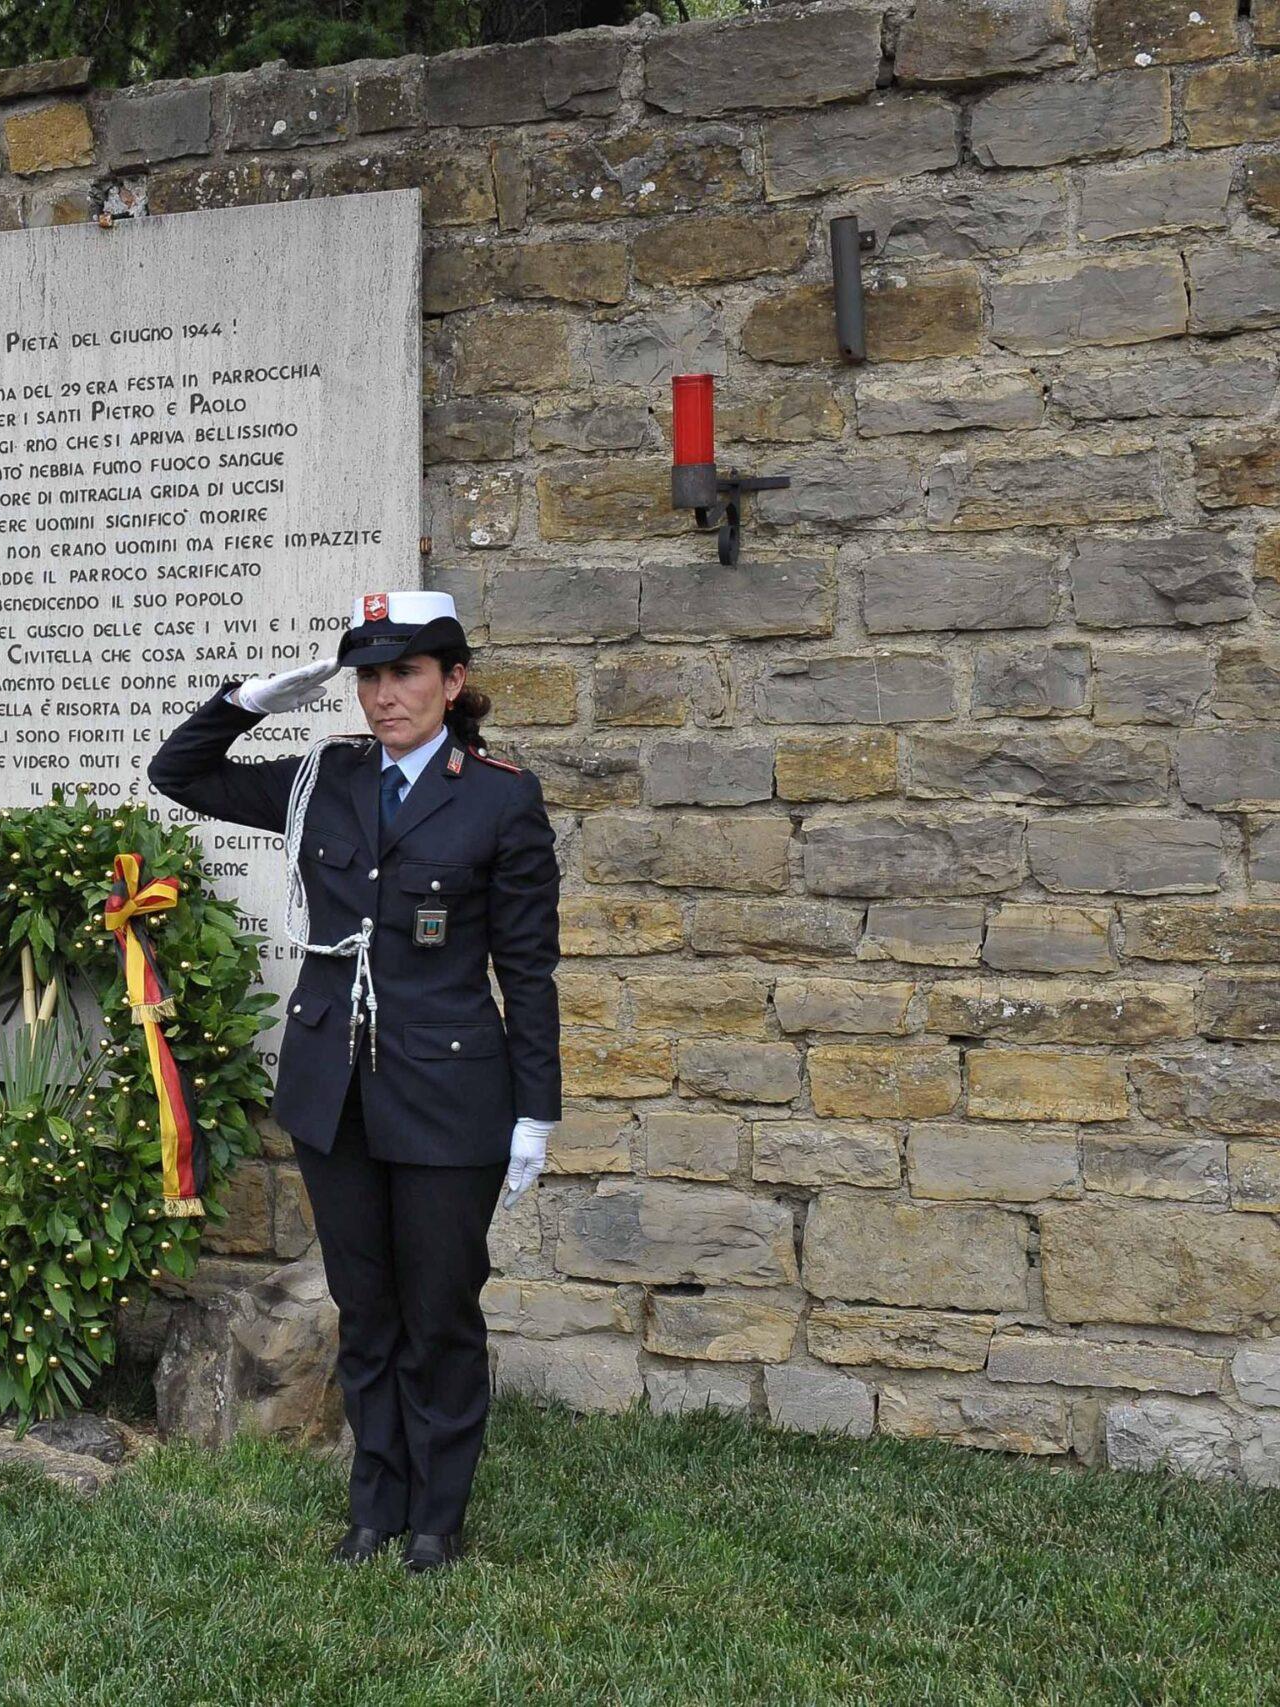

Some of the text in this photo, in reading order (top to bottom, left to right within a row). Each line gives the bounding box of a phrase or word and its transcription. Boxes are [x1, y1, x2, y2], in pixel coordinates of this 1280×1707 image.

[6, 330, 59, 353] PIETÀ
[71, 332, 101, 348] DEL
[109, 326, 174, 345] GIUGNO
[182, 322, 223, 339] 1944
[23, 384, 53, 400] DEL
[60, 382, 81, 397] 29
[85, 379, 118, 395] ERA
[127, 375, 175, 392] FESTA
[182, 374, 199, 388] IN
[212, 363, 321, 386] PARROCCHIA
[24, 412, 28, 426] I
[36, 408, 81, 425] SANTI
[91, 400, 155, 422] PIETRO
[166, 401, 177, 416] E
[190, 392, 247, 415] PAOLO
[66, 435, 99, 451] CHE
[103, 433, 120, 448] SI
[129, 430, 185, 446] APRIVA
[195, 422, 298, 443] BELLISSIMO
[29, 462, 85, 479] NEBBIA
[93, 460, 142, 476] FUMO
[150, 455, 211, 473] FUOCO
[218, 451, 284, 468] SANGUE
[38, 491, 52, 505] DI
[59, 486, 142, 504] MITRAGLIA
[150, 483, 200, 499] GRIDA
[207, 482, 224, 497] DI
[232, 478, 284, 496] UCCISI
[35, 515, 94, 532] UOMINI
[199, 507, 268, 524] MORIRE
[7, 545, 41, 559] NON
[50, 542, 107, 557] ERANO
[115, 538, 177, 555] UOMINI
[186, 537, 214, 552] MA
[224, 534, 274, 550] FIERE
[43, 570, 57, 584] IL
[69, 567, 148, 584] PARROCO
[157, 562, 262, 580] SACRIFICATO
[112, 595, 124, 609] IL
[133, 593, 167, 608] SUO
[175, 591, 244, 607] POPOLO
[26, 624, 84, 639] GUSCIO
[93, 622, 142, 638] DELLE
[154, 621, 196, 636] CASE
[205, 620, 210, 634] I
[223, 619, 257, 634] VIVI
[269, 618, 280, 632] E
[291, 617, 295, 631] I
[309, 616, 354, 632] MOR
[7, 643, 93, 665] CIVITELLA
[101, 649, 131, 663] CHE
[141, 648, 186, 663] COSA
[247, 645, 263, 660] DI
[271, 644, 300, 659] NOI
[62, 676, 111, 691] DELLE
[121, 674, 177, 690] DONNE
[56, 702, 121, 717] RISORTA
[130, 701, 152, 716] DA
[16, 729, 60, 743] SONO
[68, 729, 124, 743] FIORITI
[133, 728, 151, 742] LE
[244, 727, 311, 742] SECCATE
[12, 754, 70, 769] VIDERO
[79, 754, 120, 769] MUTI
[130, 755, 141, 769] E
[30, 782, 43, 796] IL
[167, 808, 218, 822] GIOR
[214, 835, 285, 851] DELITTO
